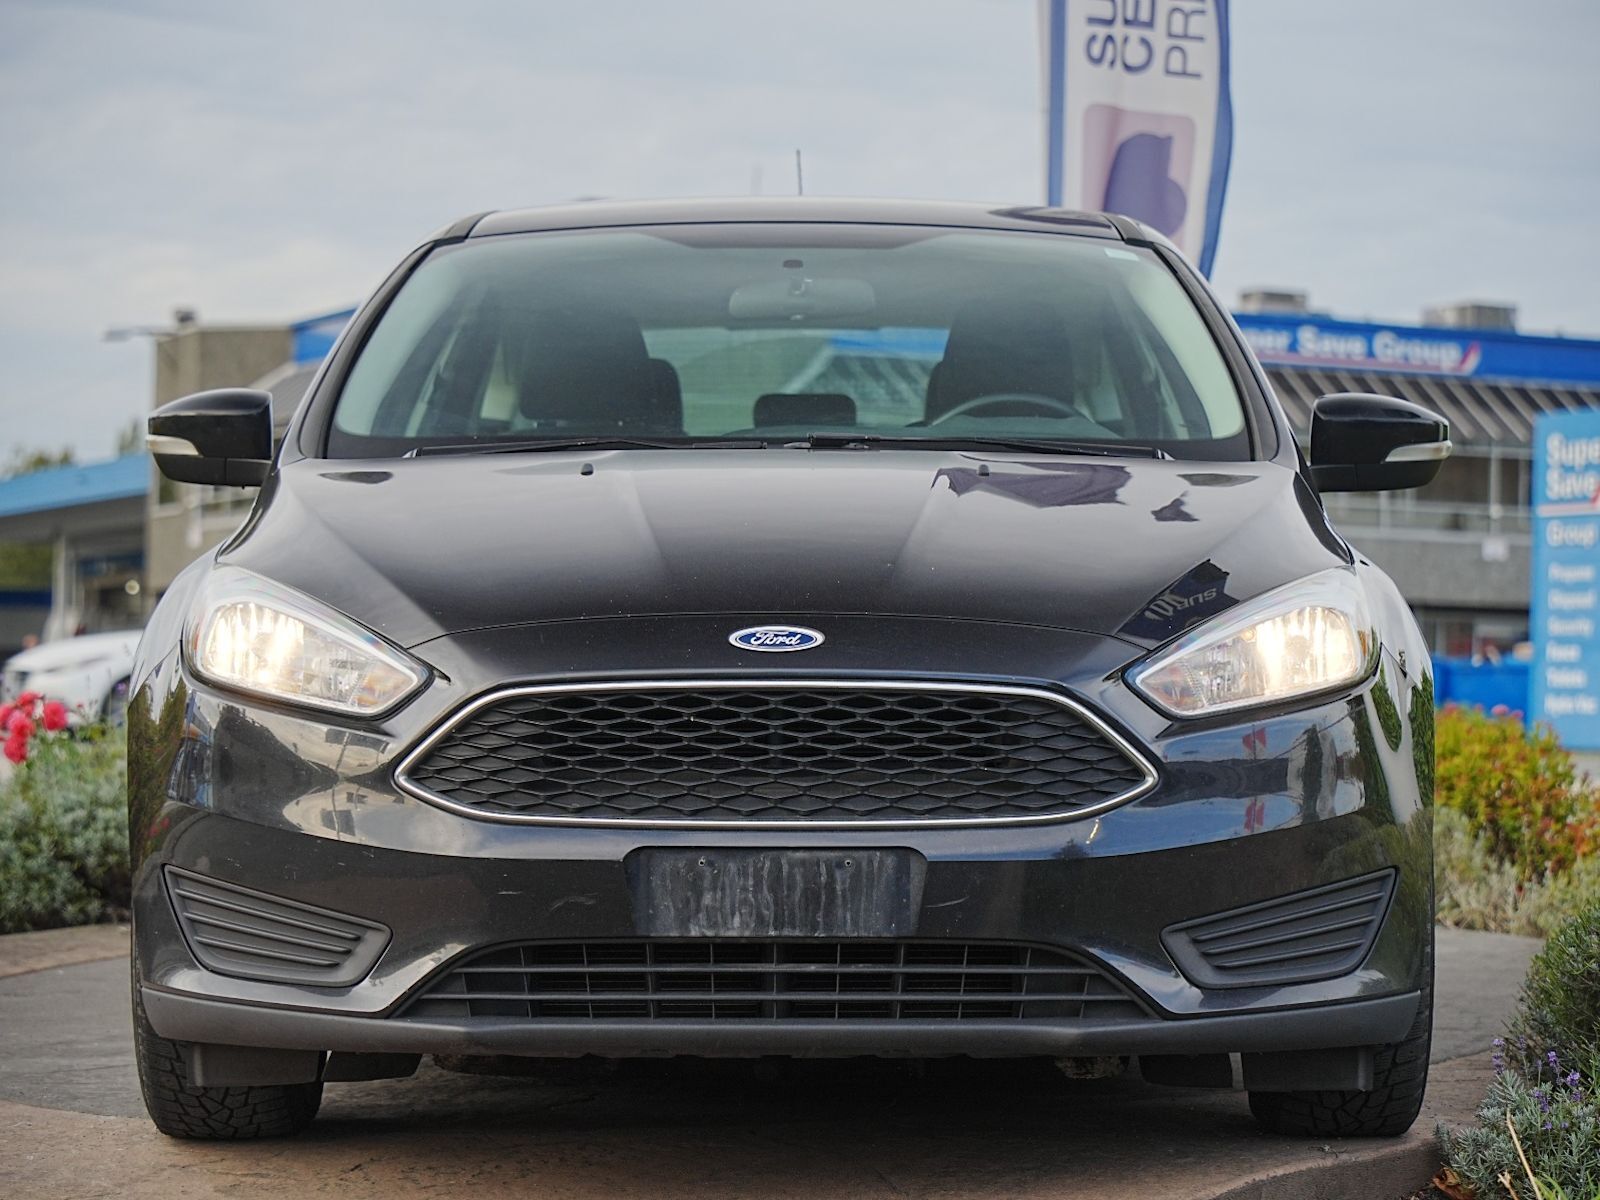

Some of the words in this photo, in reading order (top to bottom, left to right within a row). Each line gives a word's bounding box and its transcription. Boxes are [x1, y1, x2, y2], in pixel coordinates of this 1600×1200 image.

[1165, 0, 1206, 78] PR
[1297, 325, 1367, 358] Save
[1372, 330, 1462, 371] Group
[1546, 467, 1599, 500] Save
[750, 630, 801, 646] Ford
